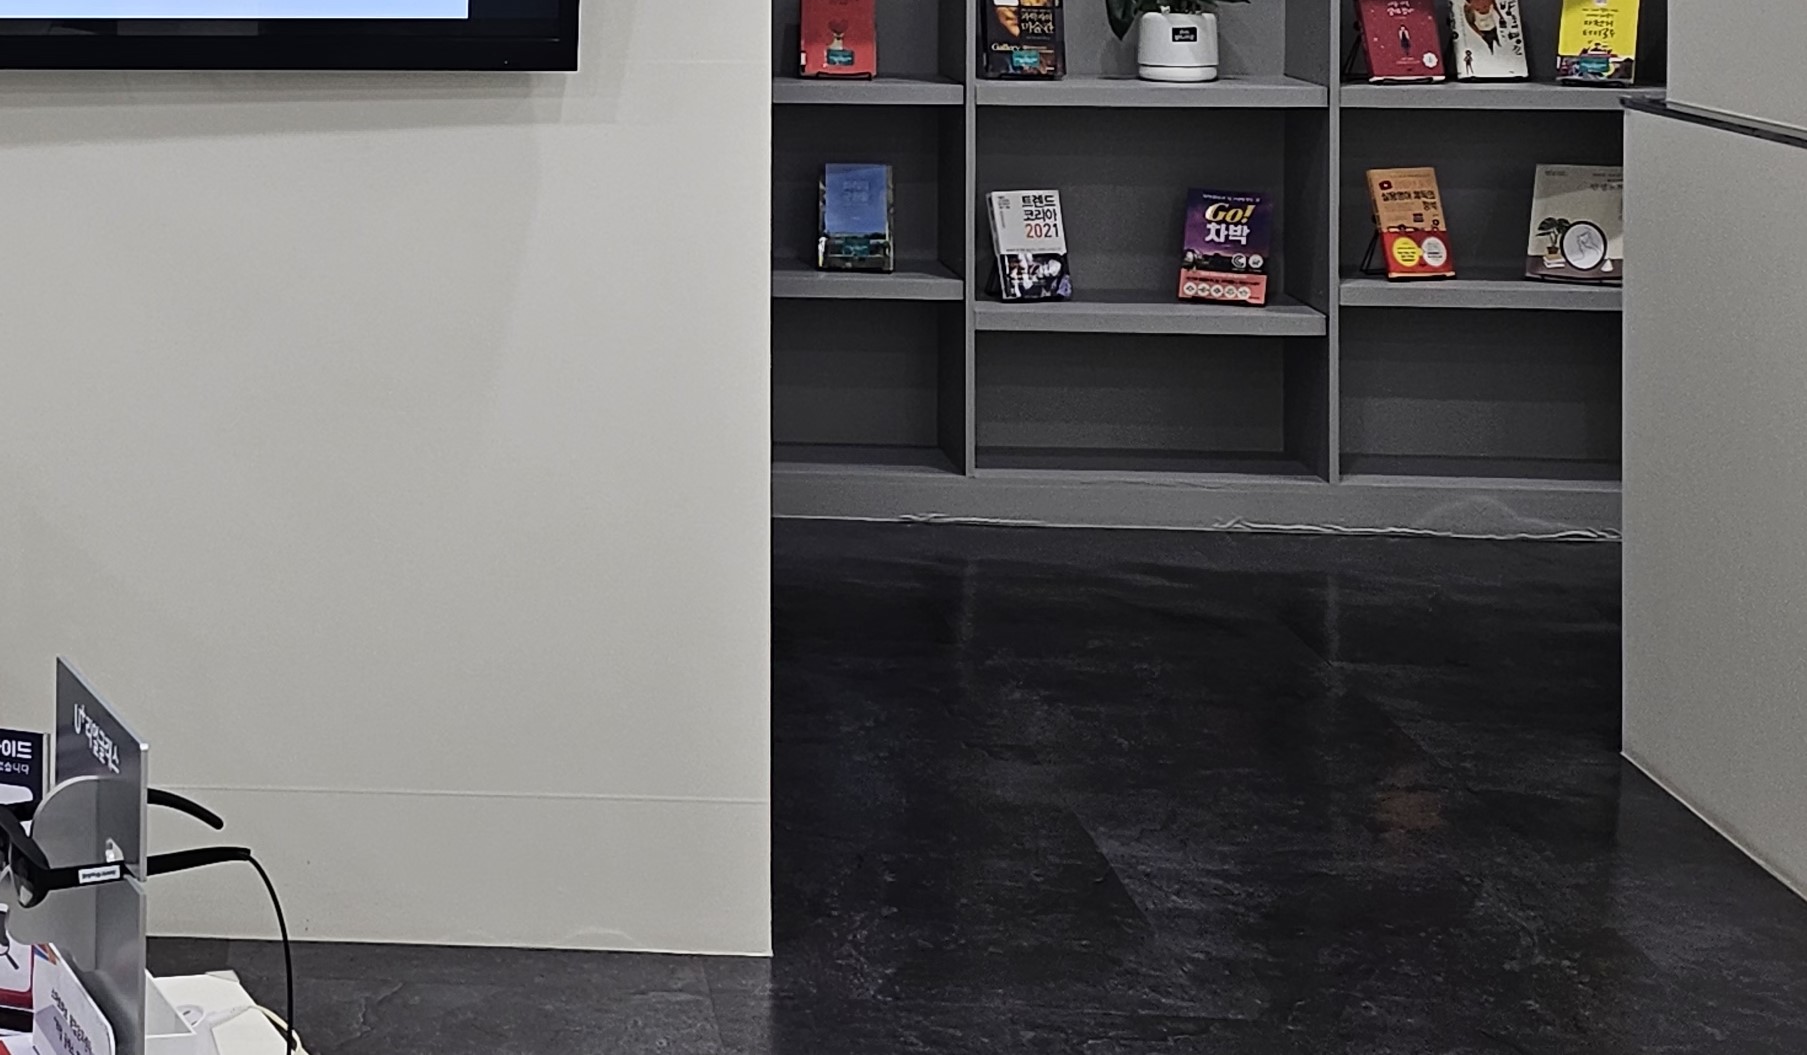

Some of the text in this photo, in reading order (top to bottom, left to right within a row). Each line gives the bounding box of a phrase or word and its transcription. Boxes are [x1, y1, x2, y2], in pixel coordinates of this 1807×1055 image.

[1021, 194, 1056, 209] 트렌드
[1023, 208, 1057, 222] 코리아
[1204, 202, 1256, 224] Go!
[1025, 223, 1059, 239] 2021
[1204, 222, 1250, 245] 차박
